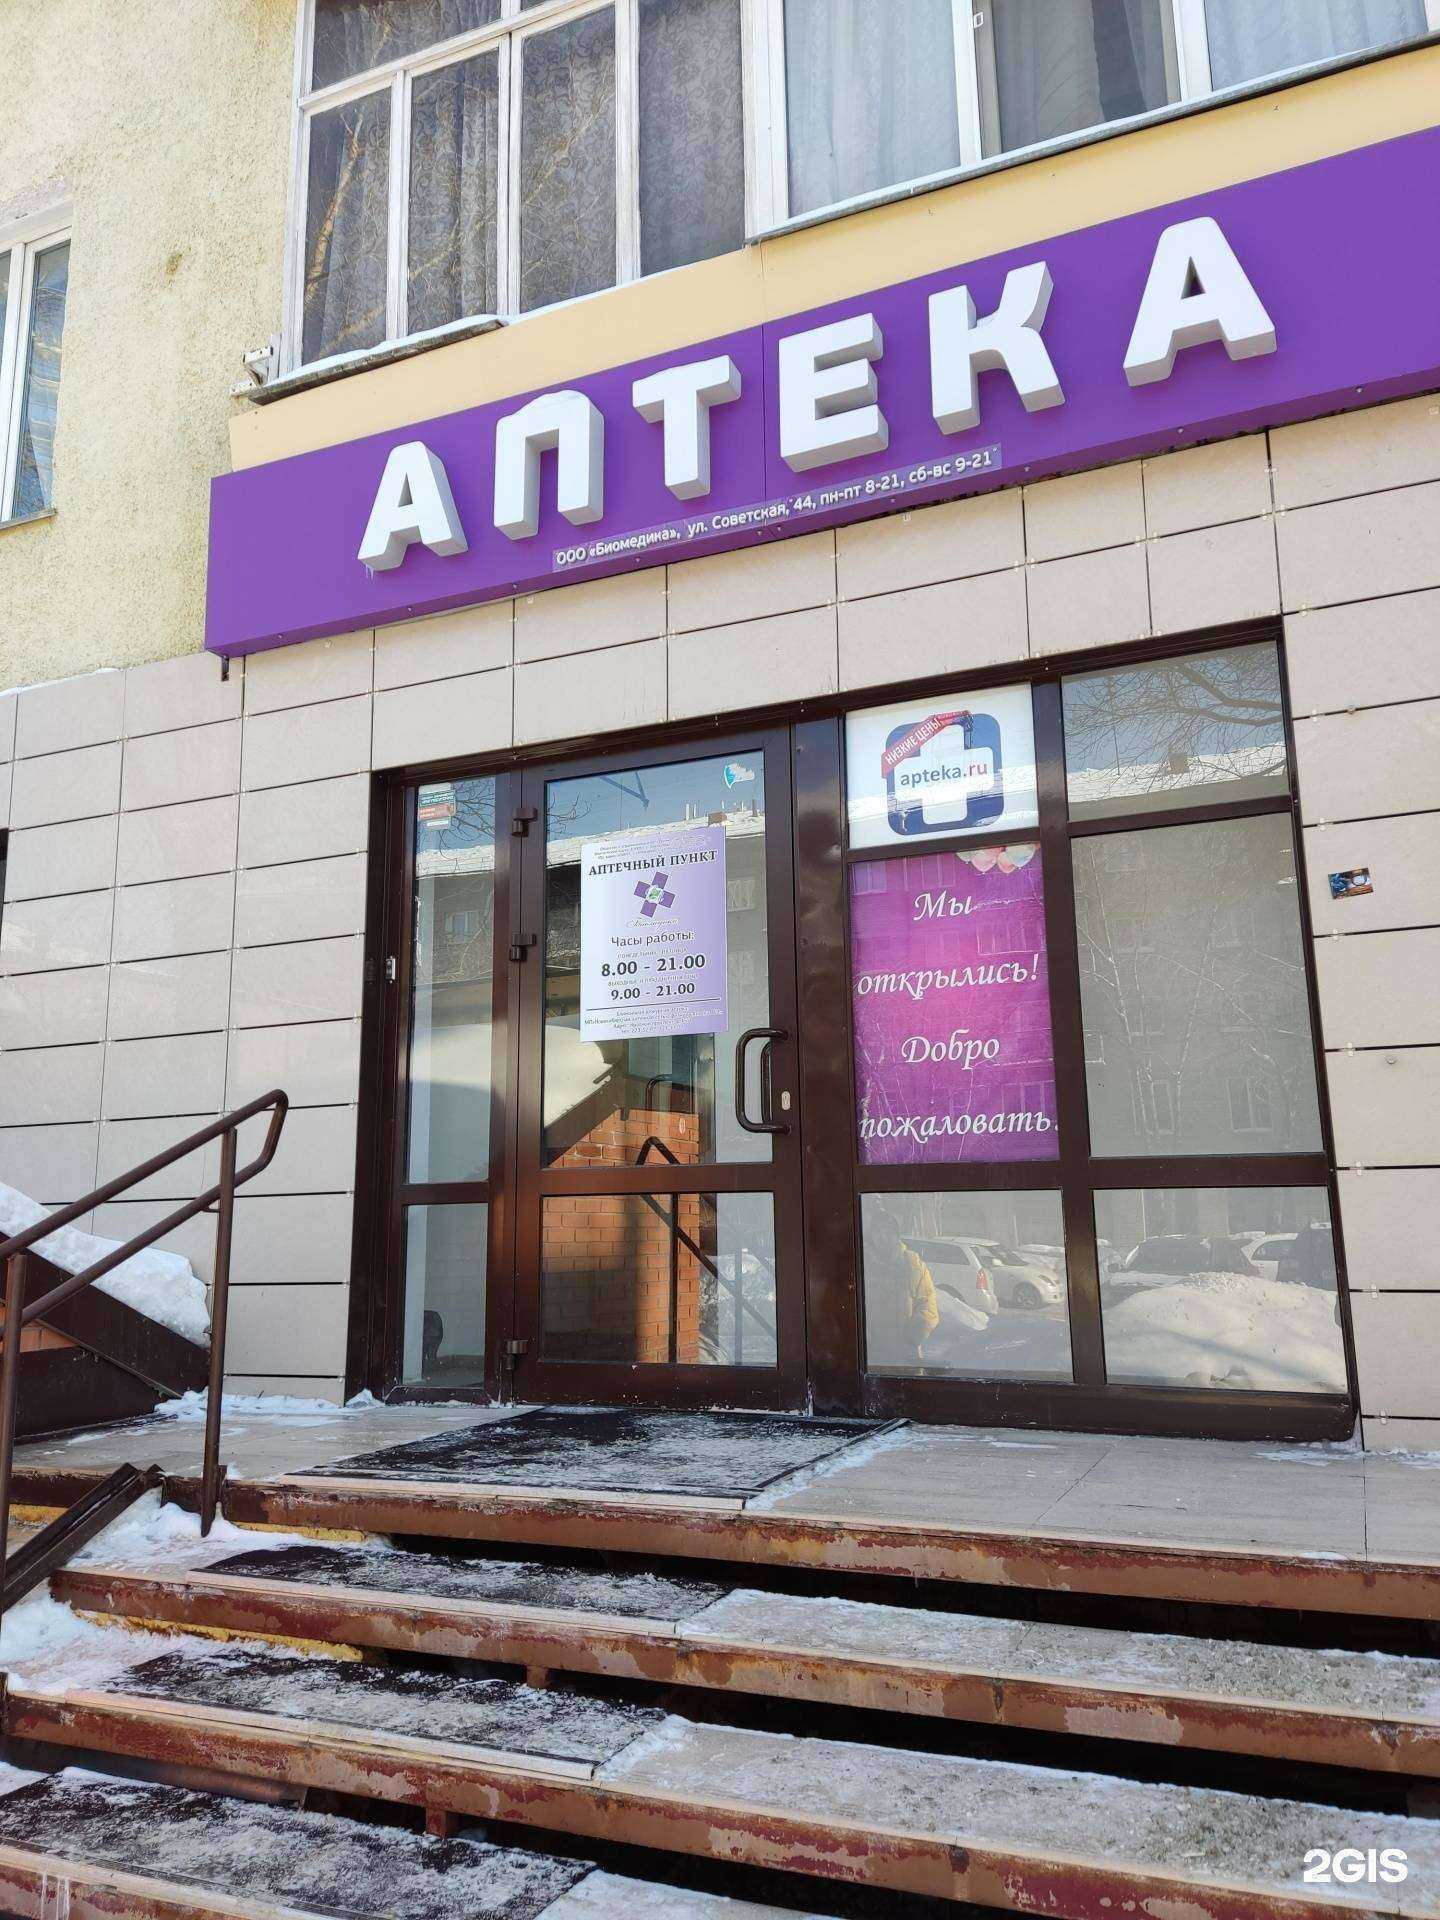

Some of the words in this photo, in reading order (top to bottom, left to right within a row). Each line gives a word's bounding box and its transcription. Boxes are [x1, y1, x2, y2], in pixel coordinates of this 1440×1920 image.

[357, 216, 1278, 572] АПТЕКА
[556, 547, 587, 565] ООО
[687, 521, 708, 538] ул.
[712, 503, 790, 530] Советская,
[793, 495, 817, 511] 44,
[820, 485, 861, 506] пн-пт
[865, 473, 905, 494] 8-21,
[909, 463, 951, 483] сб-вс
[955, 451, 992, 473] 9-21
[884, 735, 919, 766] НИЗКИЕ
[915, 717, 942, 744] ЦЕНЫ
[900, 762, 988, 788] apteka.ru
[588, 854, 665, 876] АПТЕЧНЫЙ
[670, 850, 718, 866] ПУНКТ
[913, 890, 974, 920] Мы
[611, 936, 642, 947] Часы
[646, 931, 695, 947] работы:
[601, 961, 638, 977] 8.00
[656, 954, 706, 971] 21.00
[857, 953, 1040, 1001] открылись!
[610, 986, 641, 1000] 9.00
[656, 982, 696, 997] 21.00
[901, 1028, 1000, 1071] Добро
